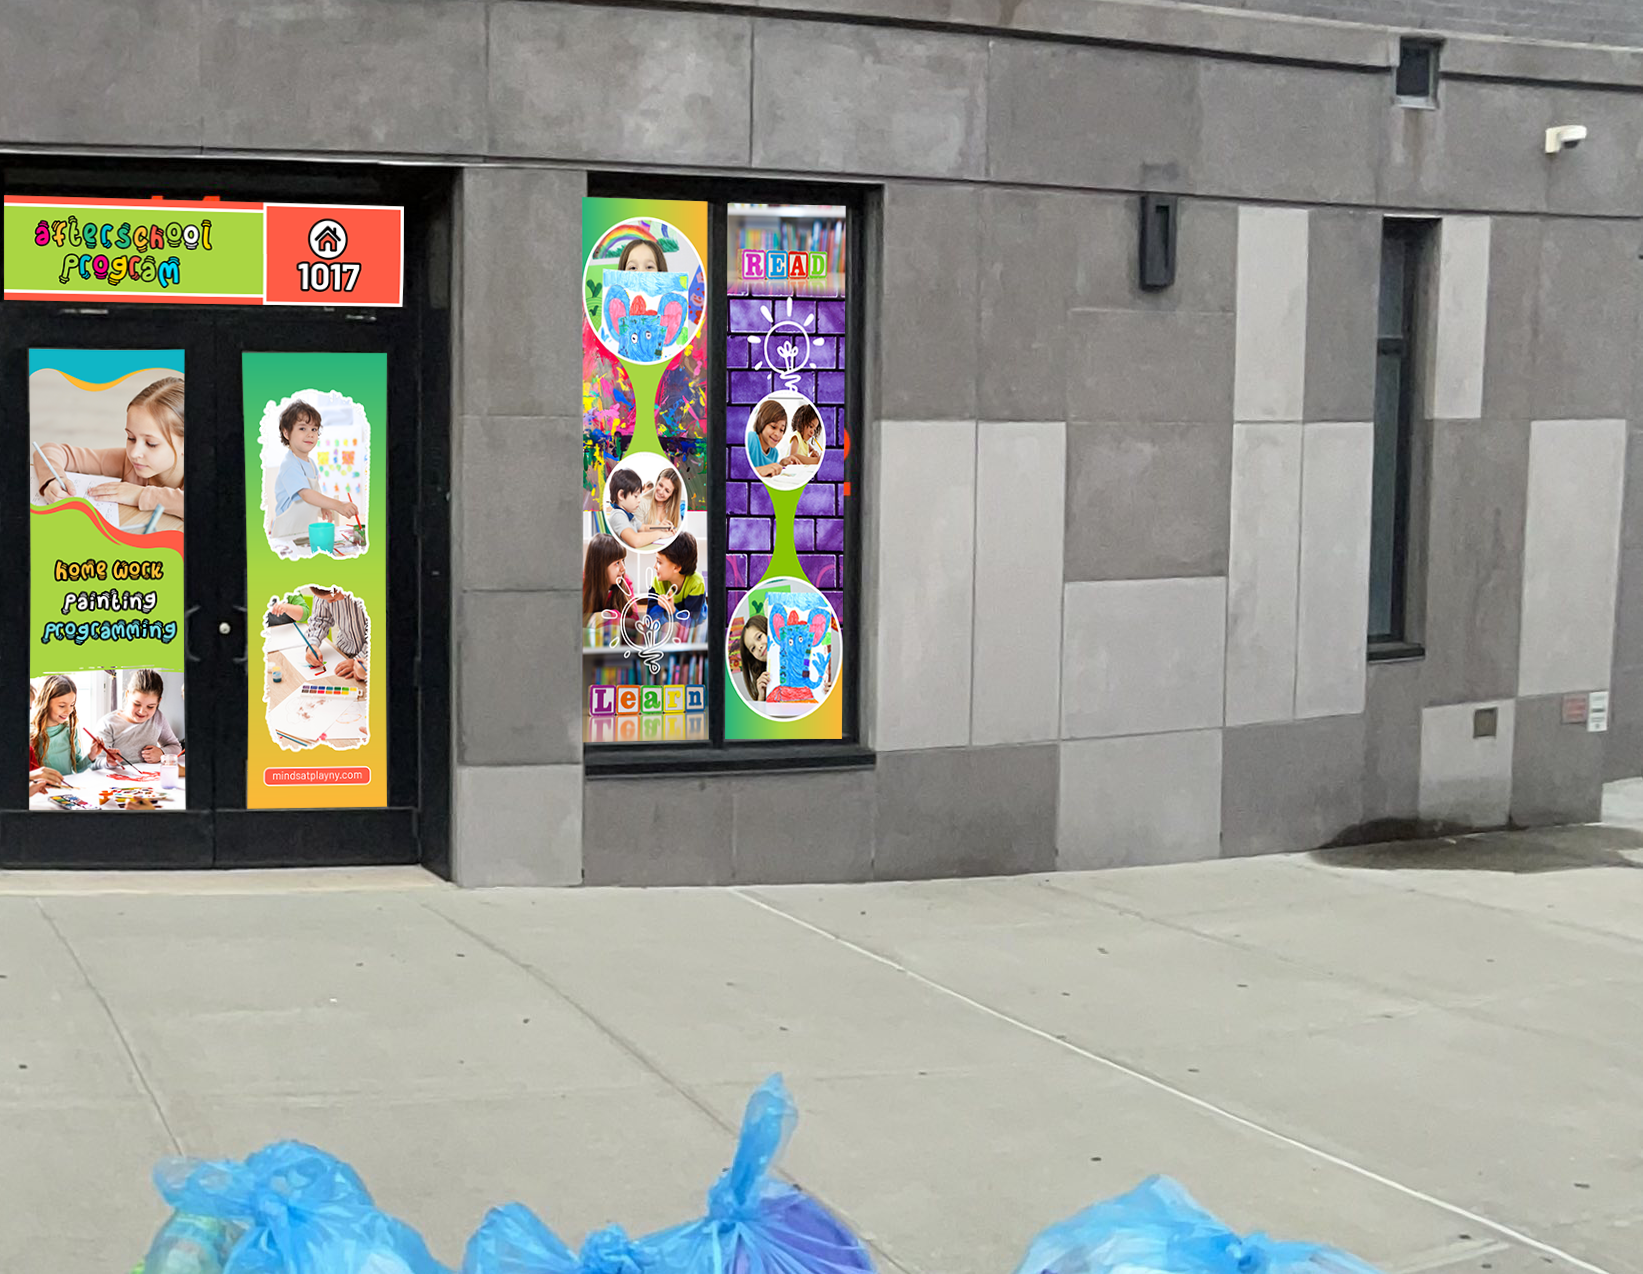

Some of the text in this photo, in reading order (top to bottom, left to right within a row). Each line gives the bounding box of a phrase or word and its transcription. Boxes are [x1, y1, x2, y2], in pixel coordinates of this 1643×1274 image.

[296, 261, 362, 292] 1017
[744, 252, 826, 277] READ
[593, 688, 703, 714] Learn
[271, 769, 363, 784] mindsatplayny.com
